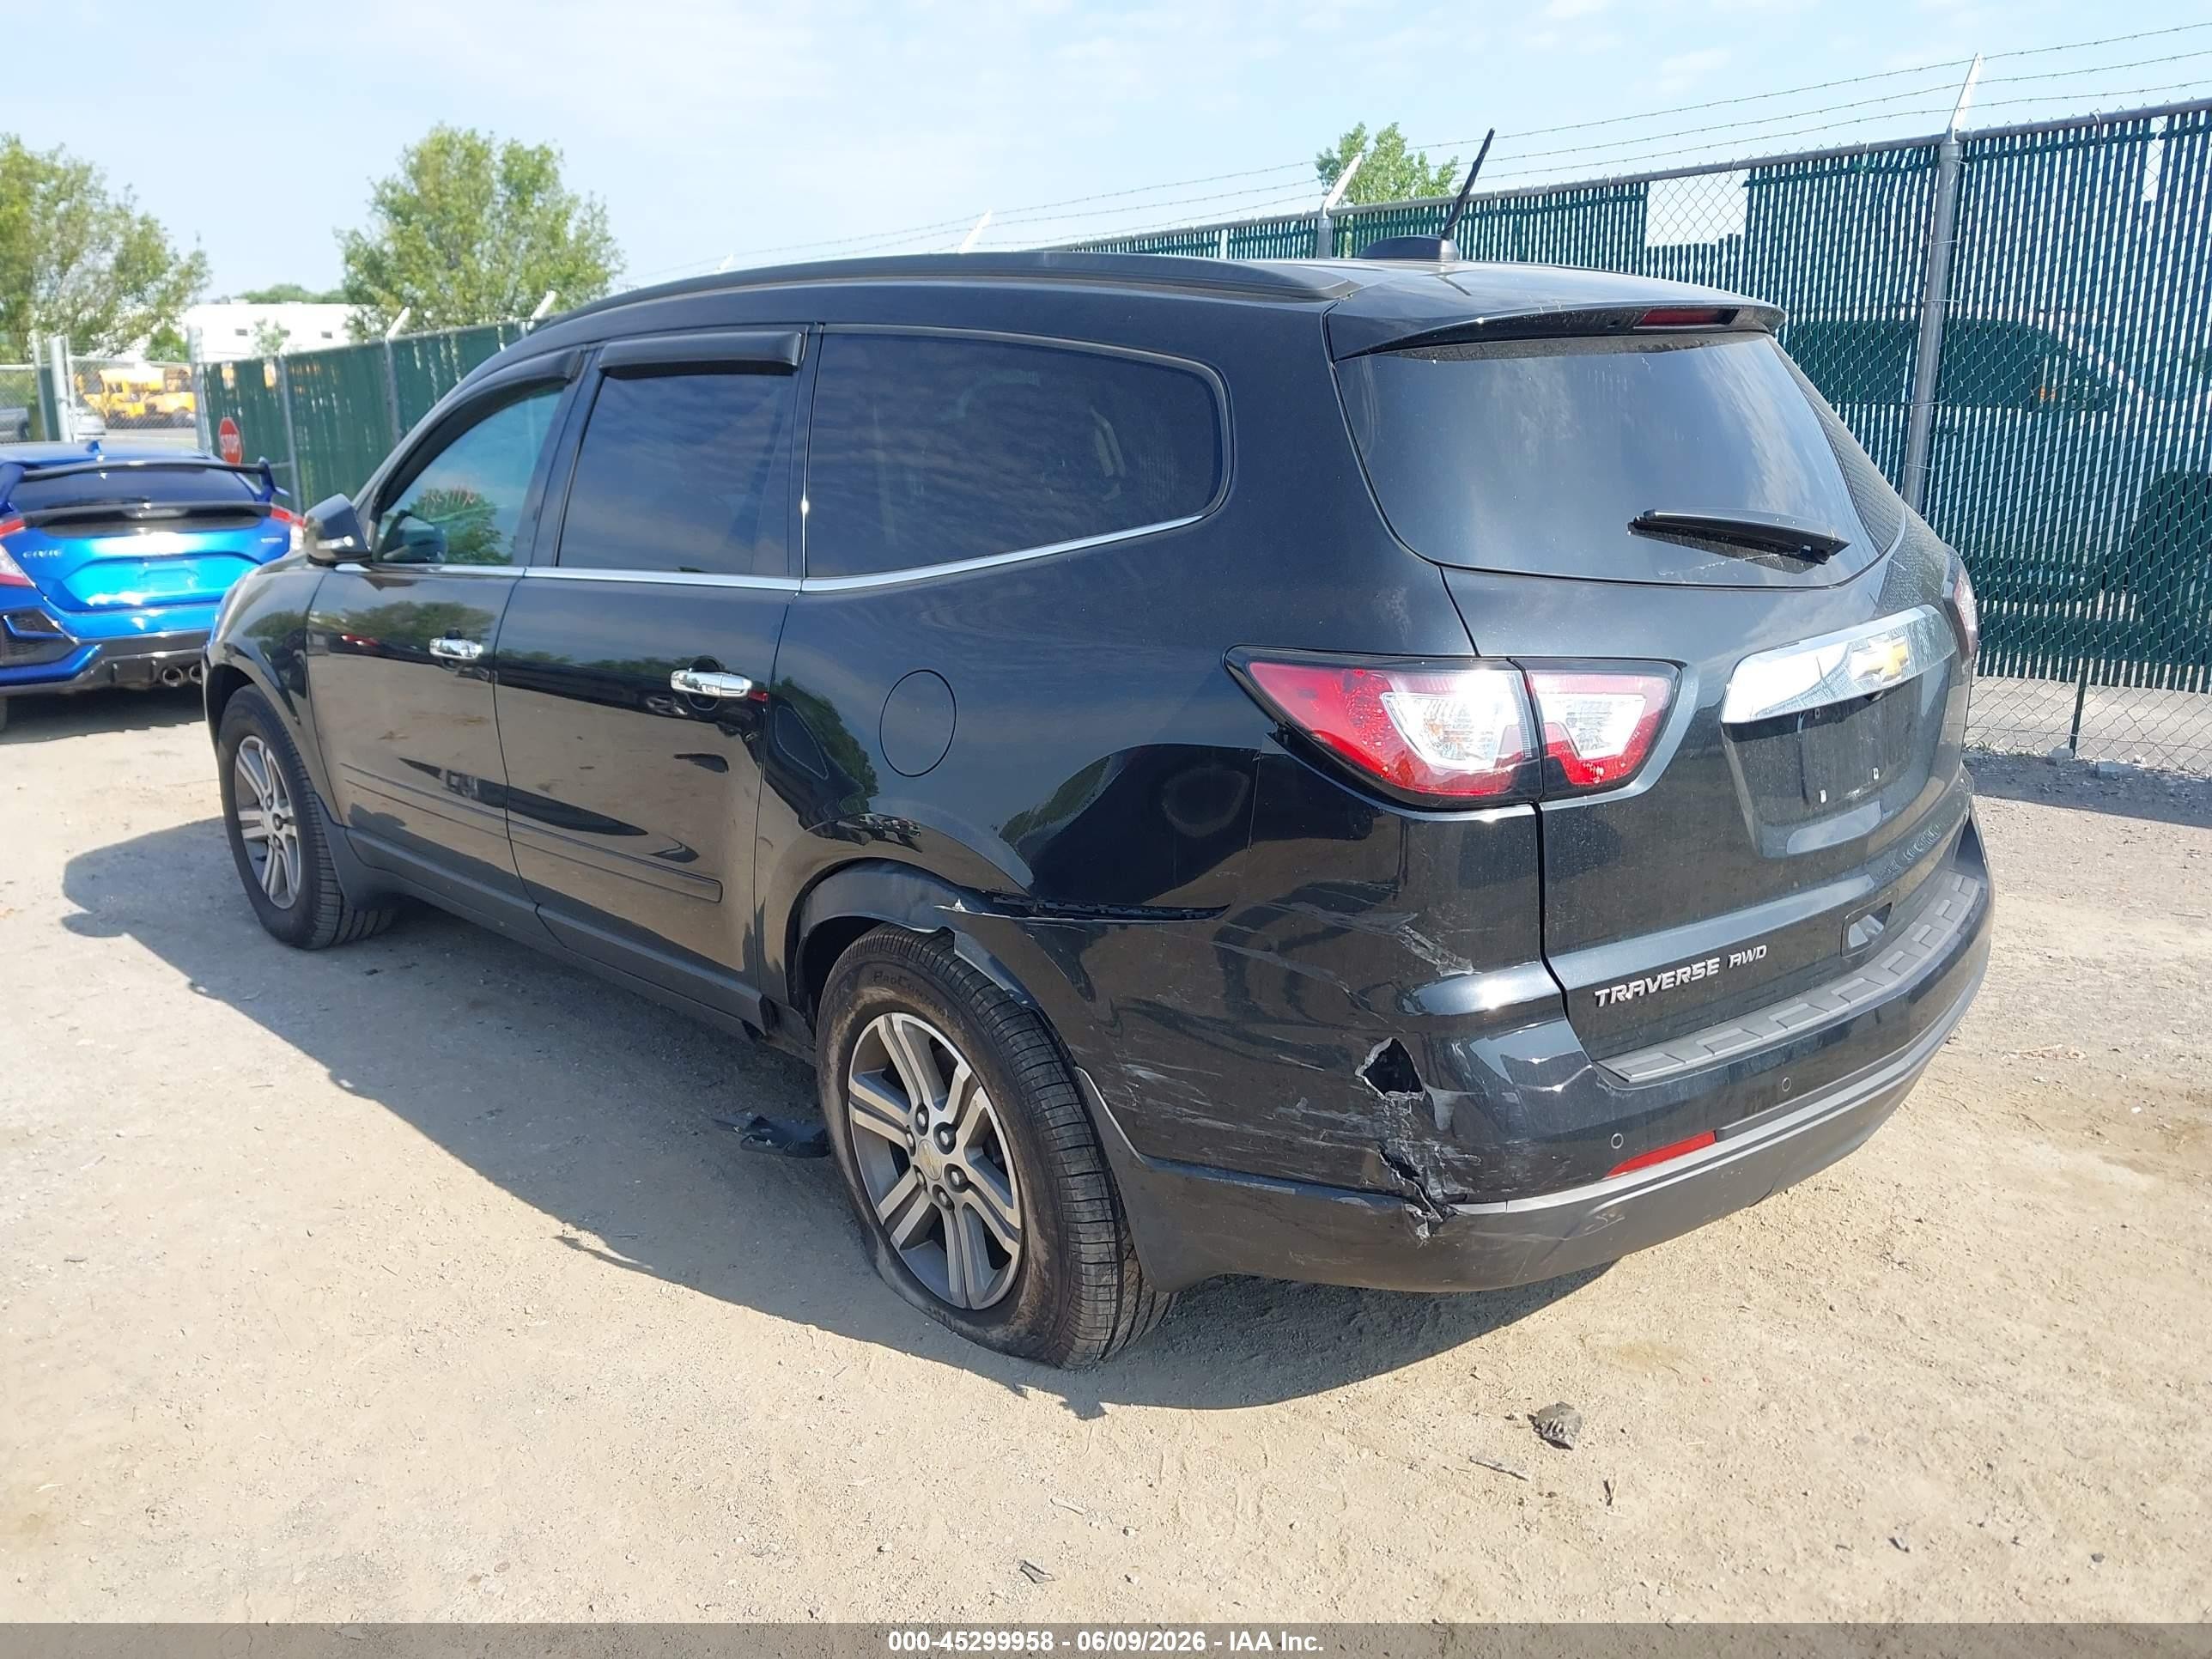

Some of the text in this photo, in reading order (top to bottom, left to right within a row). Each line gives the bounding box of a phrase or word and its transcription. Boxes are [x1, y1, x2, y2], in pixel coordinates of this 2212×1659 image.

[220, 434, 240, 454] STOP
[1595, 945, 1768, 1007] TRAVERSE AWD
